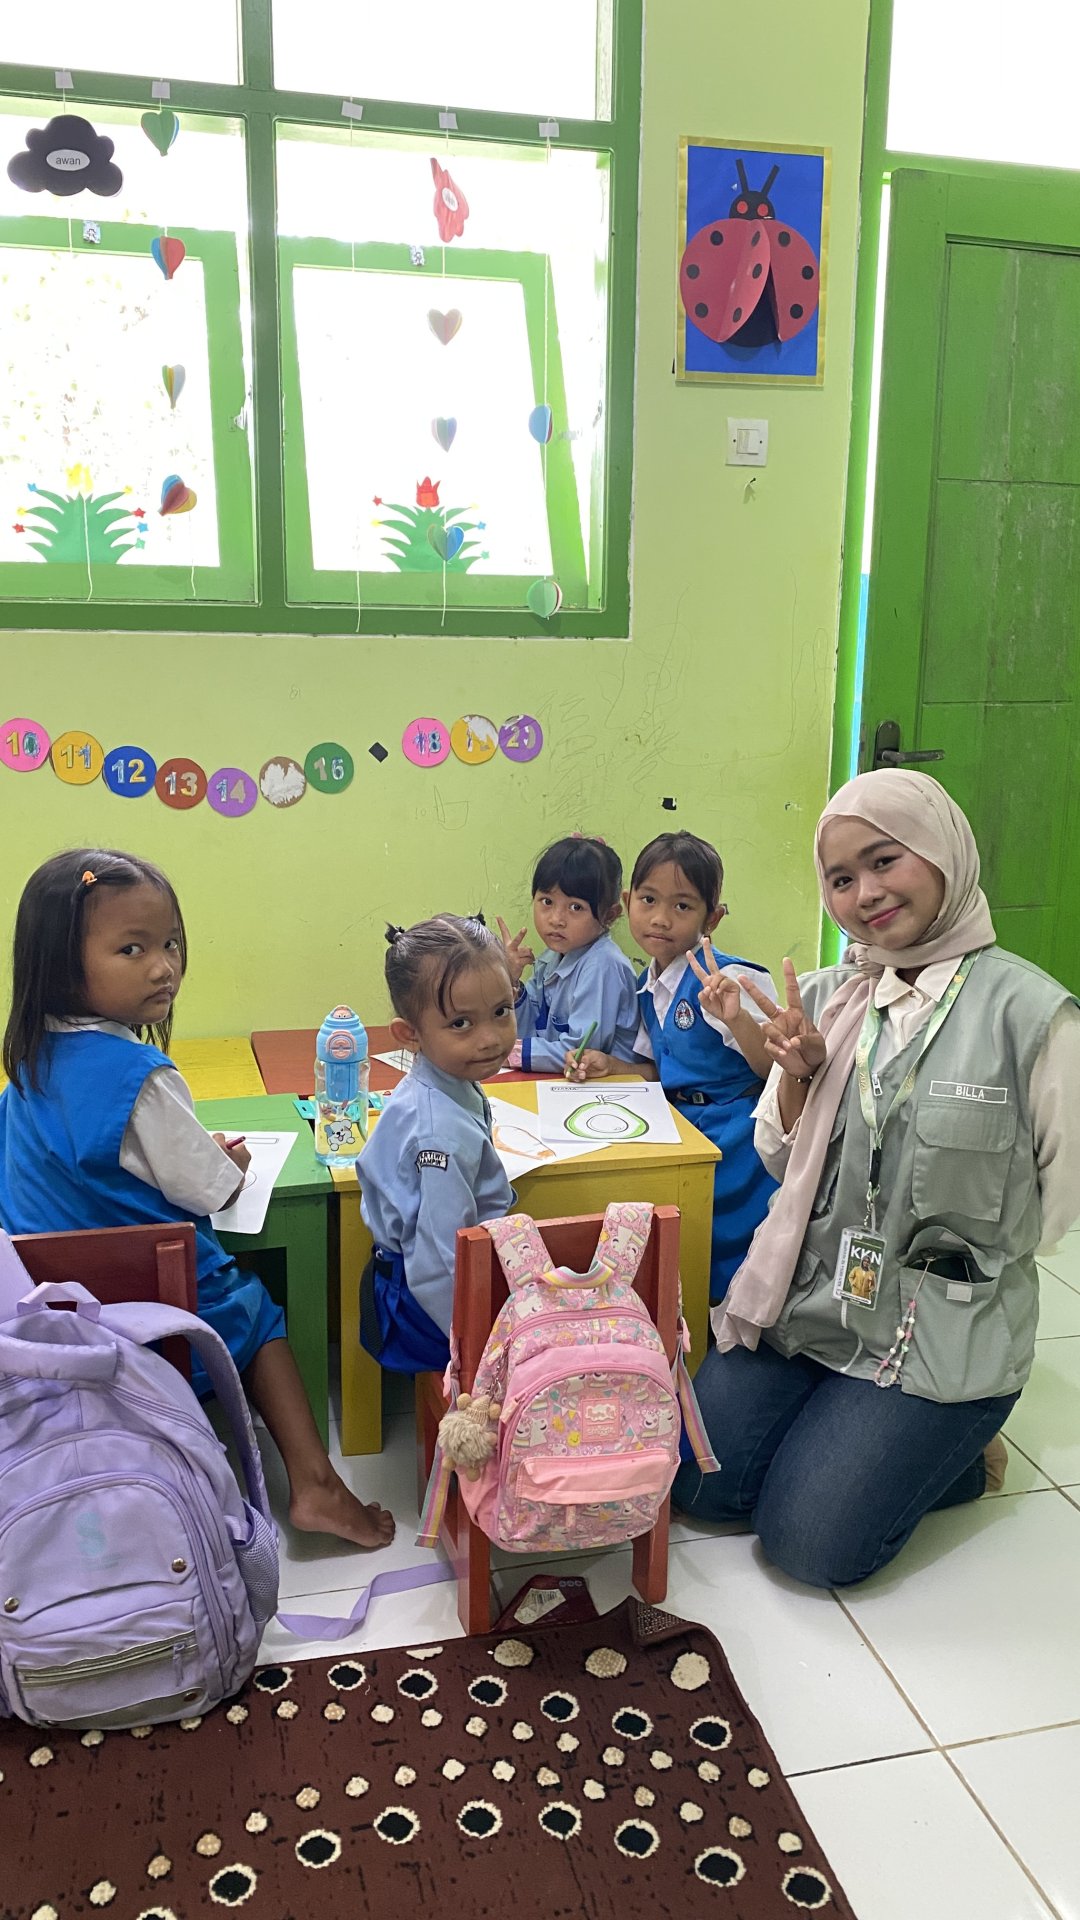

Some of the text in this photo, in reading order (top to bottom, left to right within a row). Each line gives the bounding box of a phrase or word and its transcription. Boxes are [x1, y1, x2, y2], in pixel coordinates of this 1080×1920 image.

[55, 155, 81, 166] awan
[6, 731, 41, 758] 10
[413, 729, 442, 755] 18
[60, 742, 93, 770] 11
[313, 756, 345, 781] 16
[111, 758, 147, 784] 12
[164, 771, 198, 797] 13
[214, 777, 246, 804] 14
[955, 1085, 985, 1100] BILLA
[850, 1245, 882, 1266] KKN
